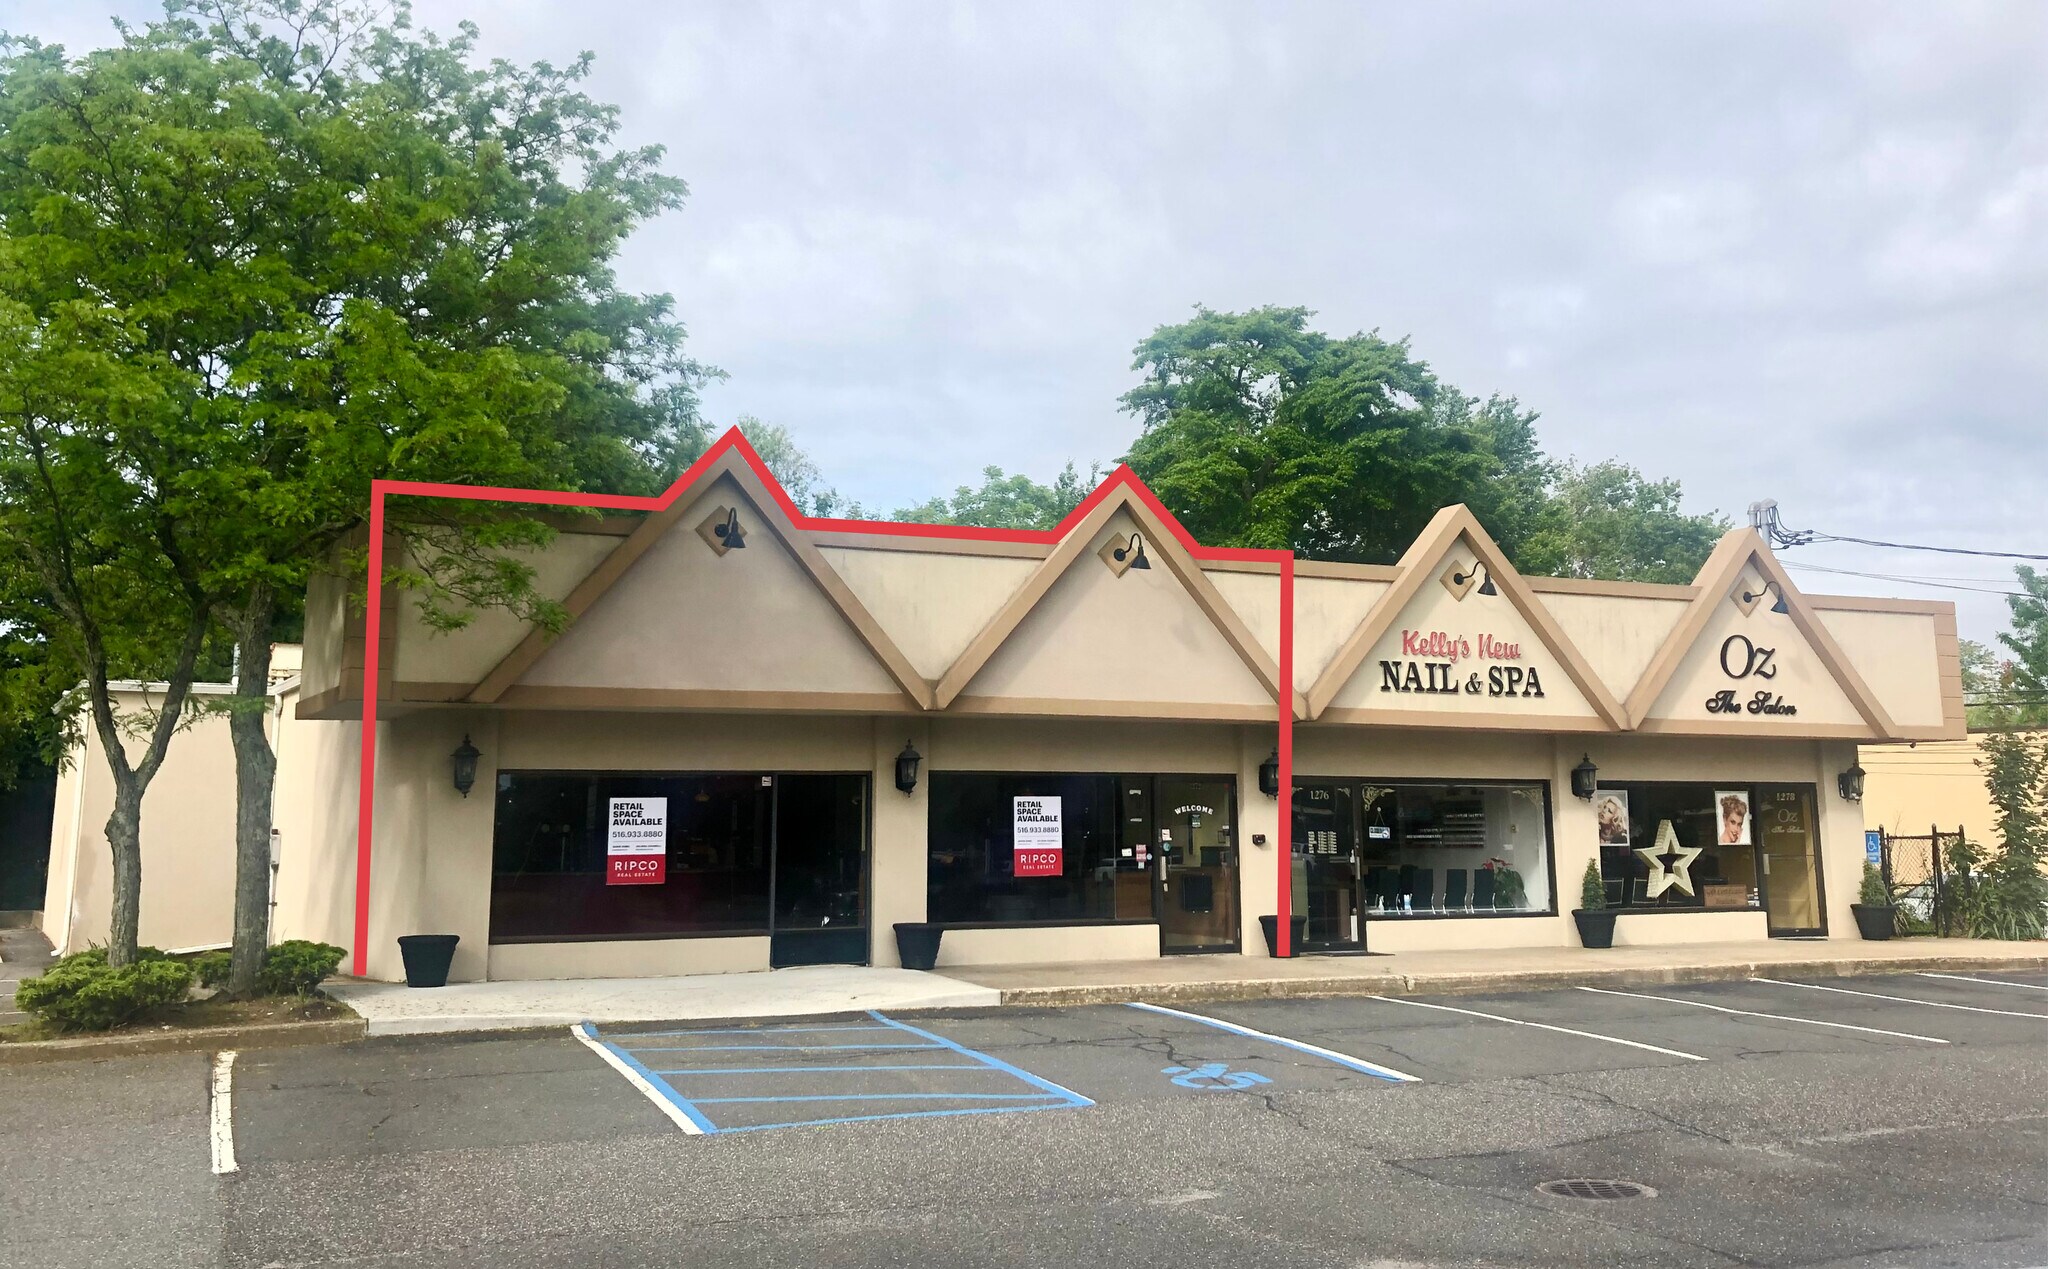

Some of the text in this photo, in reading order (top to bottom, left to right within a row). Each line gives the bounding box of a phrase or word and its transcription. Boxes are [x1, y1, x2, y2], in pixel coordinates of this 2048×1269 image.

[1402, 629, 1521, 663] Kelly's New
[1720, 634, 1777, 679] Oz
[1379, 660, 1545, 697] NAIL & SPA
[1705, 690, 1798, 715] The Salon
[1310, 790, 1330, 800] 1276
[613, 802, 644, 810] RETAIL
[1174, 804, 1214, 815] WELCOME
[613, 810, 643, 818] SPACE
[612, 818, 663, 826] AVAILABLE
[612, 830, 663, 838] 516.933.8880
[1020, 854, 1056, 864] RIPCO
[614, 860, 658, 871] RIPCO
